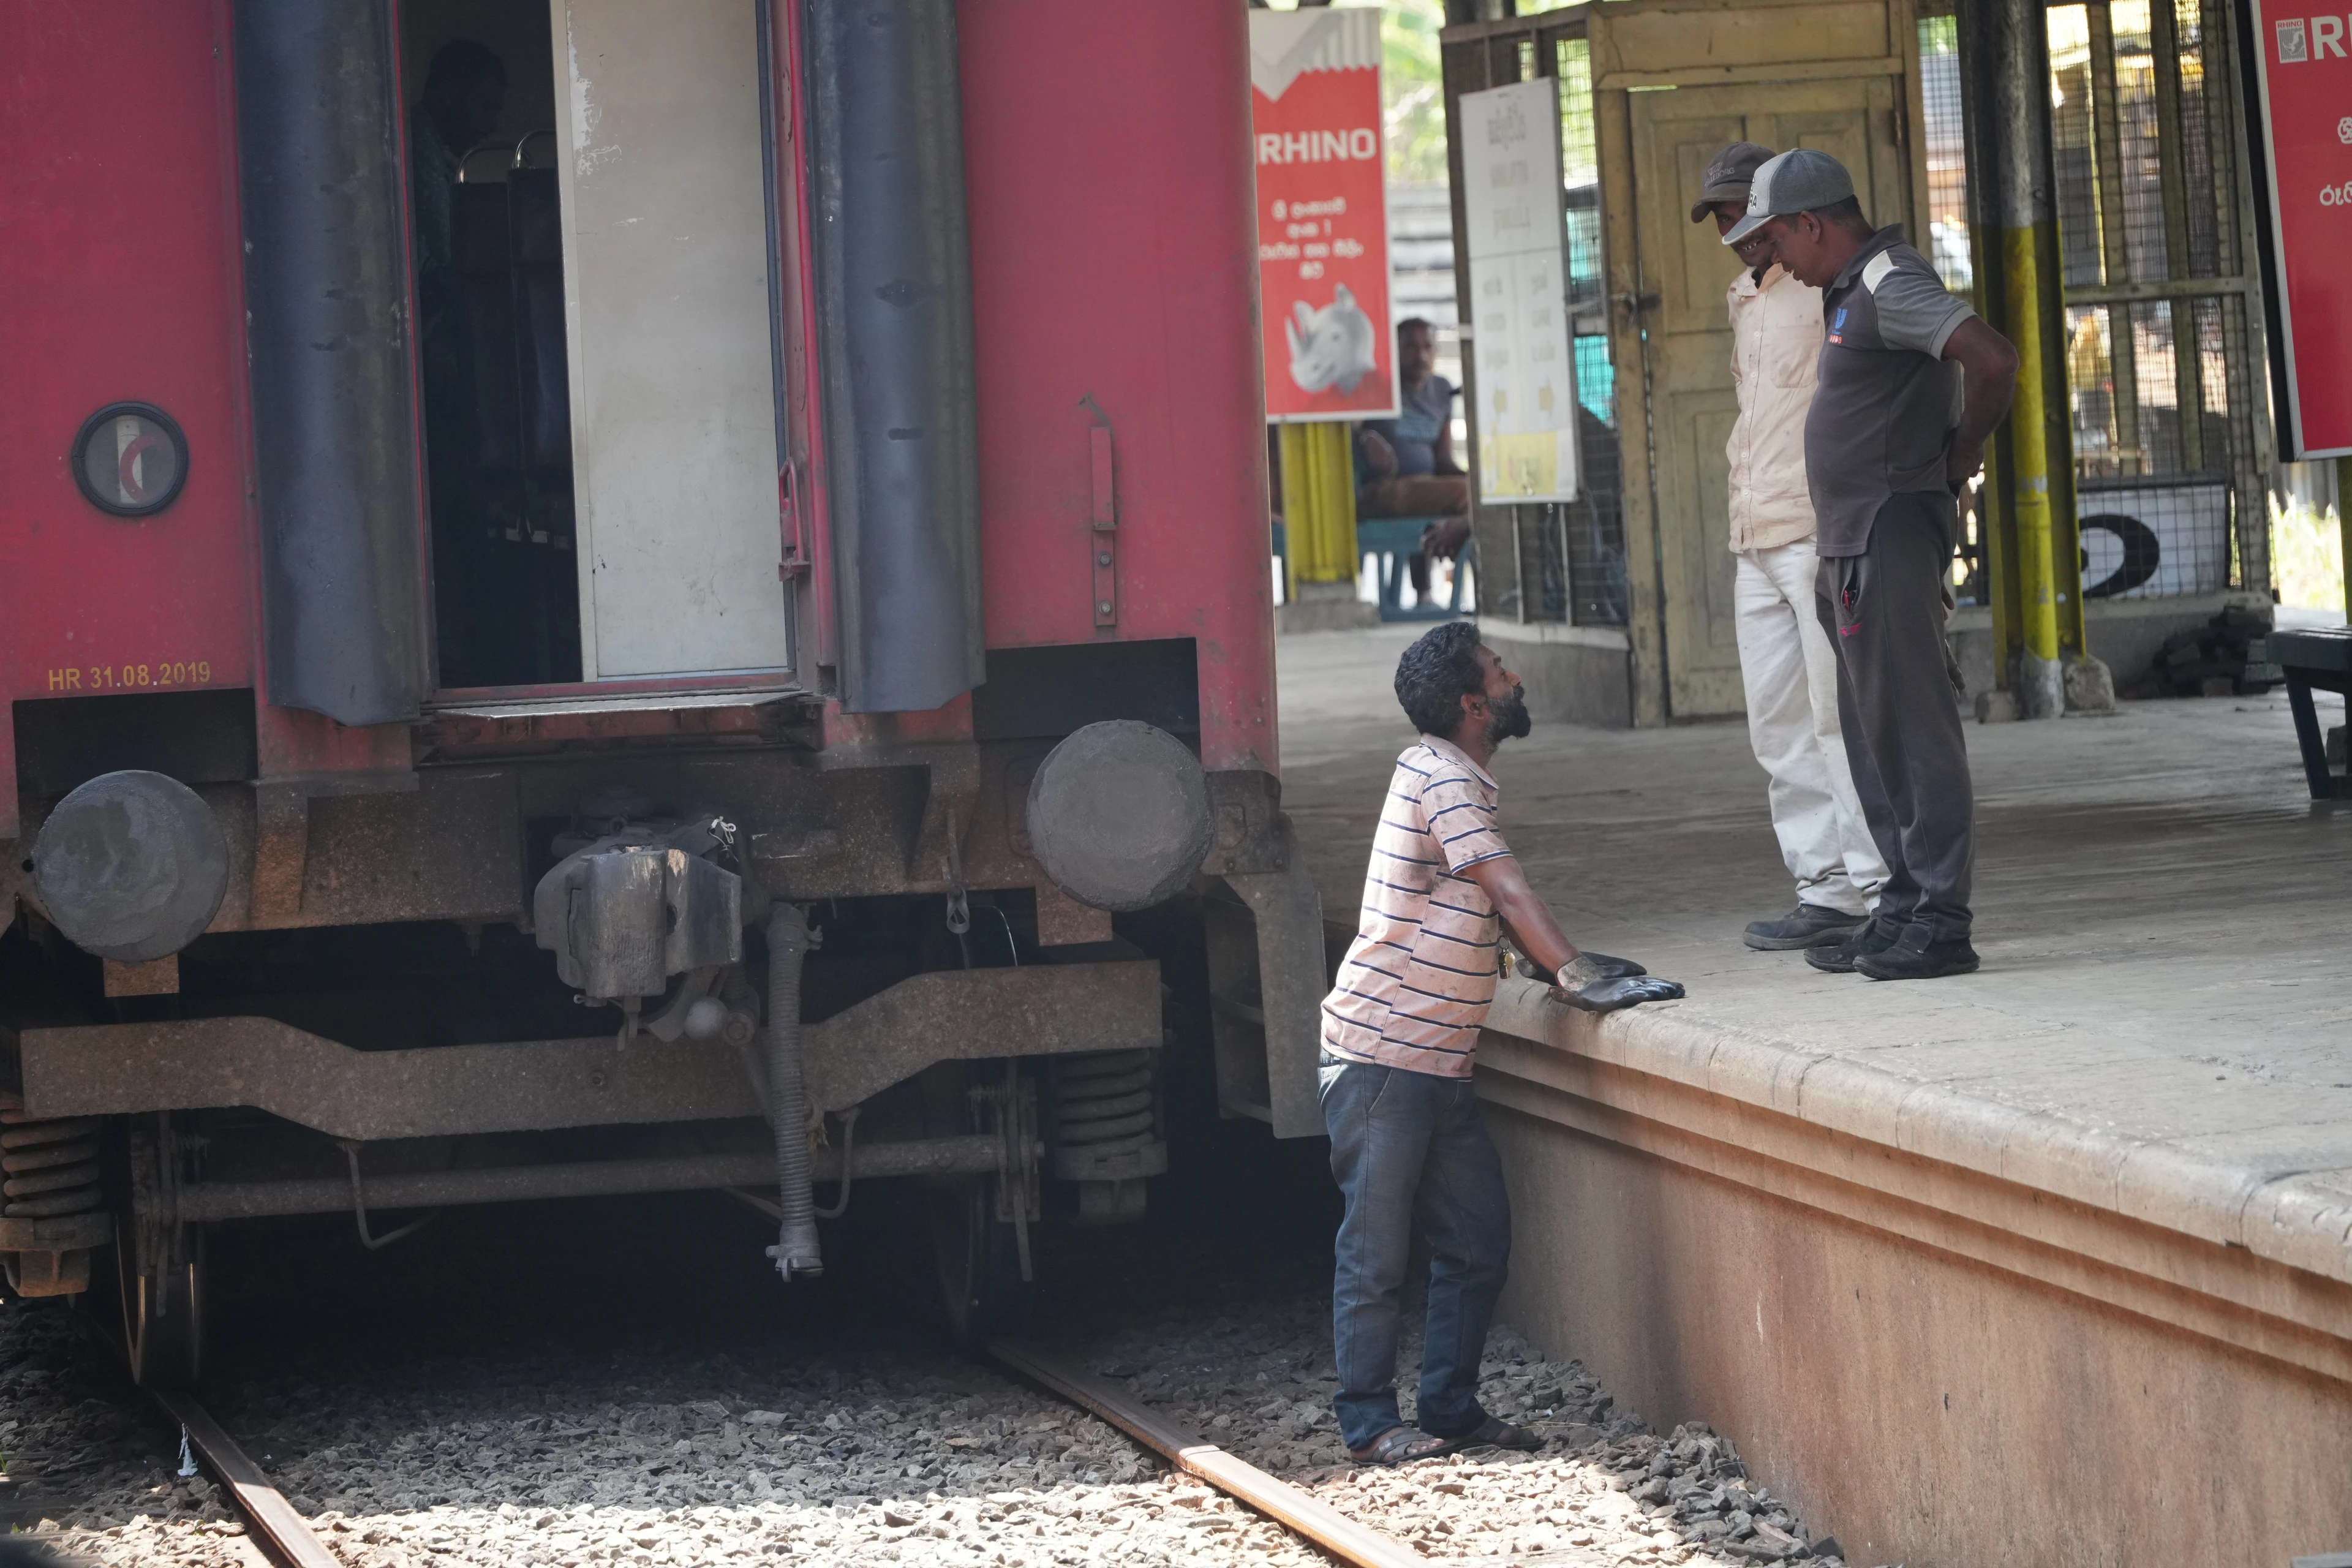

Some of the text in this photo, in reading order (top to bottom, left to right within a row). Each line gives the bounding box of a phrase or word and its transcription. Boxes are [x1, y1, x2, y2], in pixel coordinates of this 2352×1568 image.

[1259, 128, 1376, 165] RHINO
[48, 661, 211, 690] HR 31.08.2019
